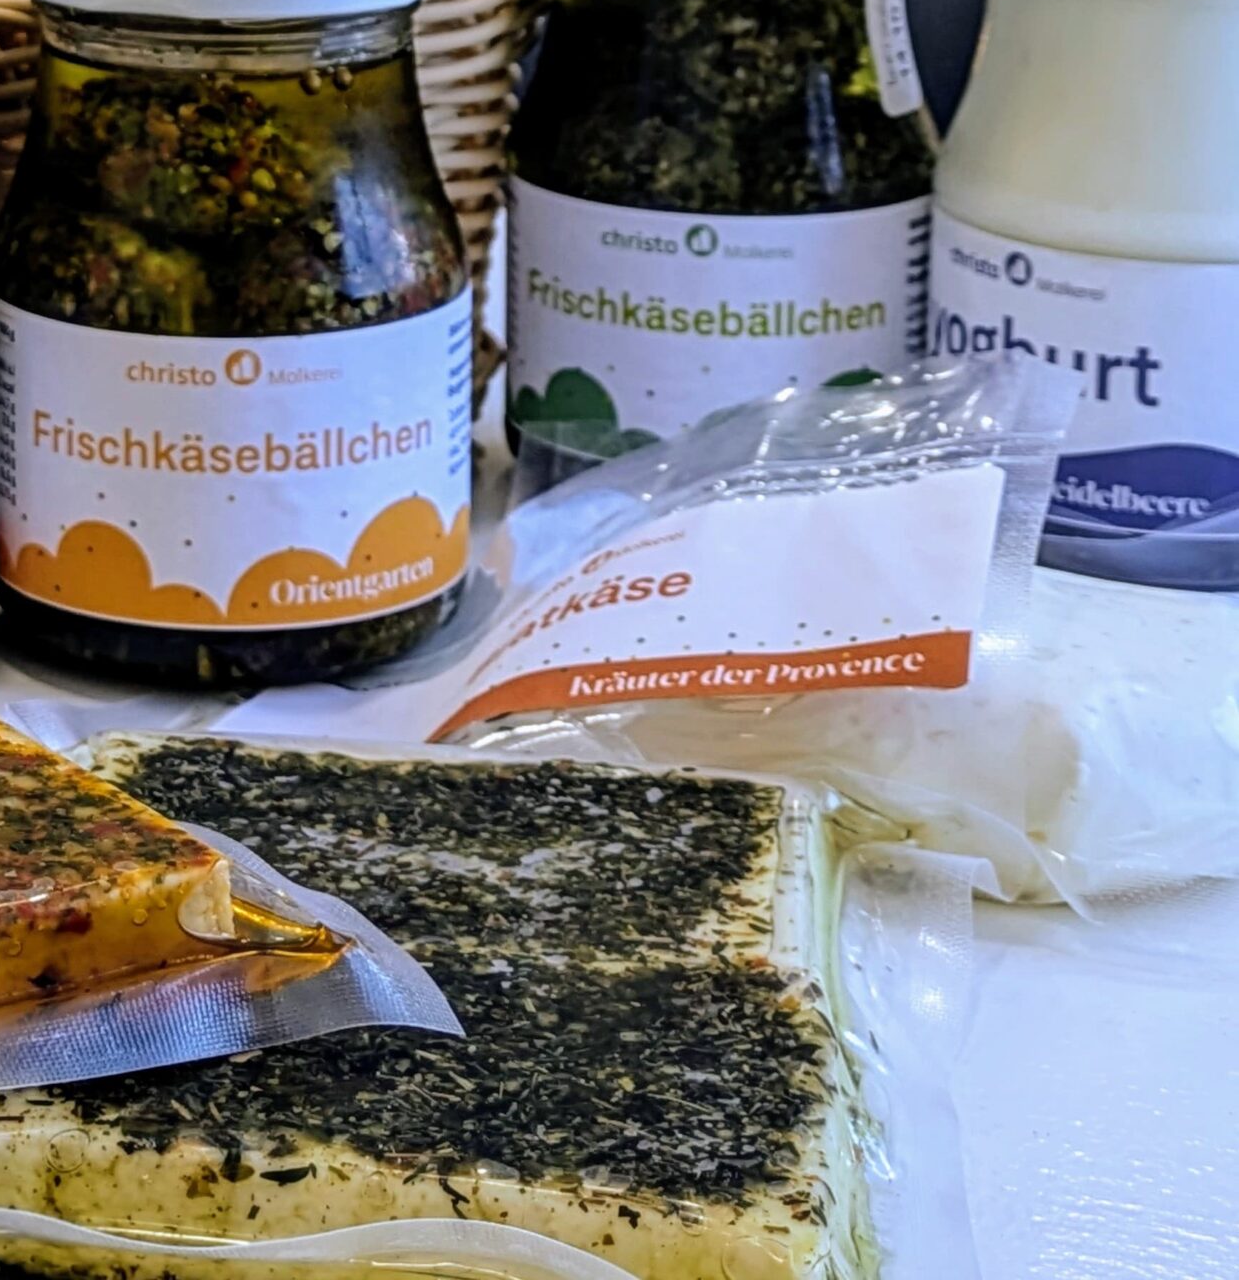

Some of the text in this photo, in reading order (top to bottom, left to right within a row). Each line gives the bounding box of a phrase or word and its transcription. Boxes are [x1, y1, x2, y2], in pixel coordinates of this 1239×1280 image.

[600, 228, 680, 256] christo
[526, 266, 888, 339] Frischkäsebällchen
[125, 360, 218, 386] christo
[32, 408, 434, 473] Frischkäsebällchen
[1051, 476, 1212, 519] eidelbeere
[269, 555, 435, 605] Orientgarten
[569, 649, 926, 698] Kräuter der Provence
